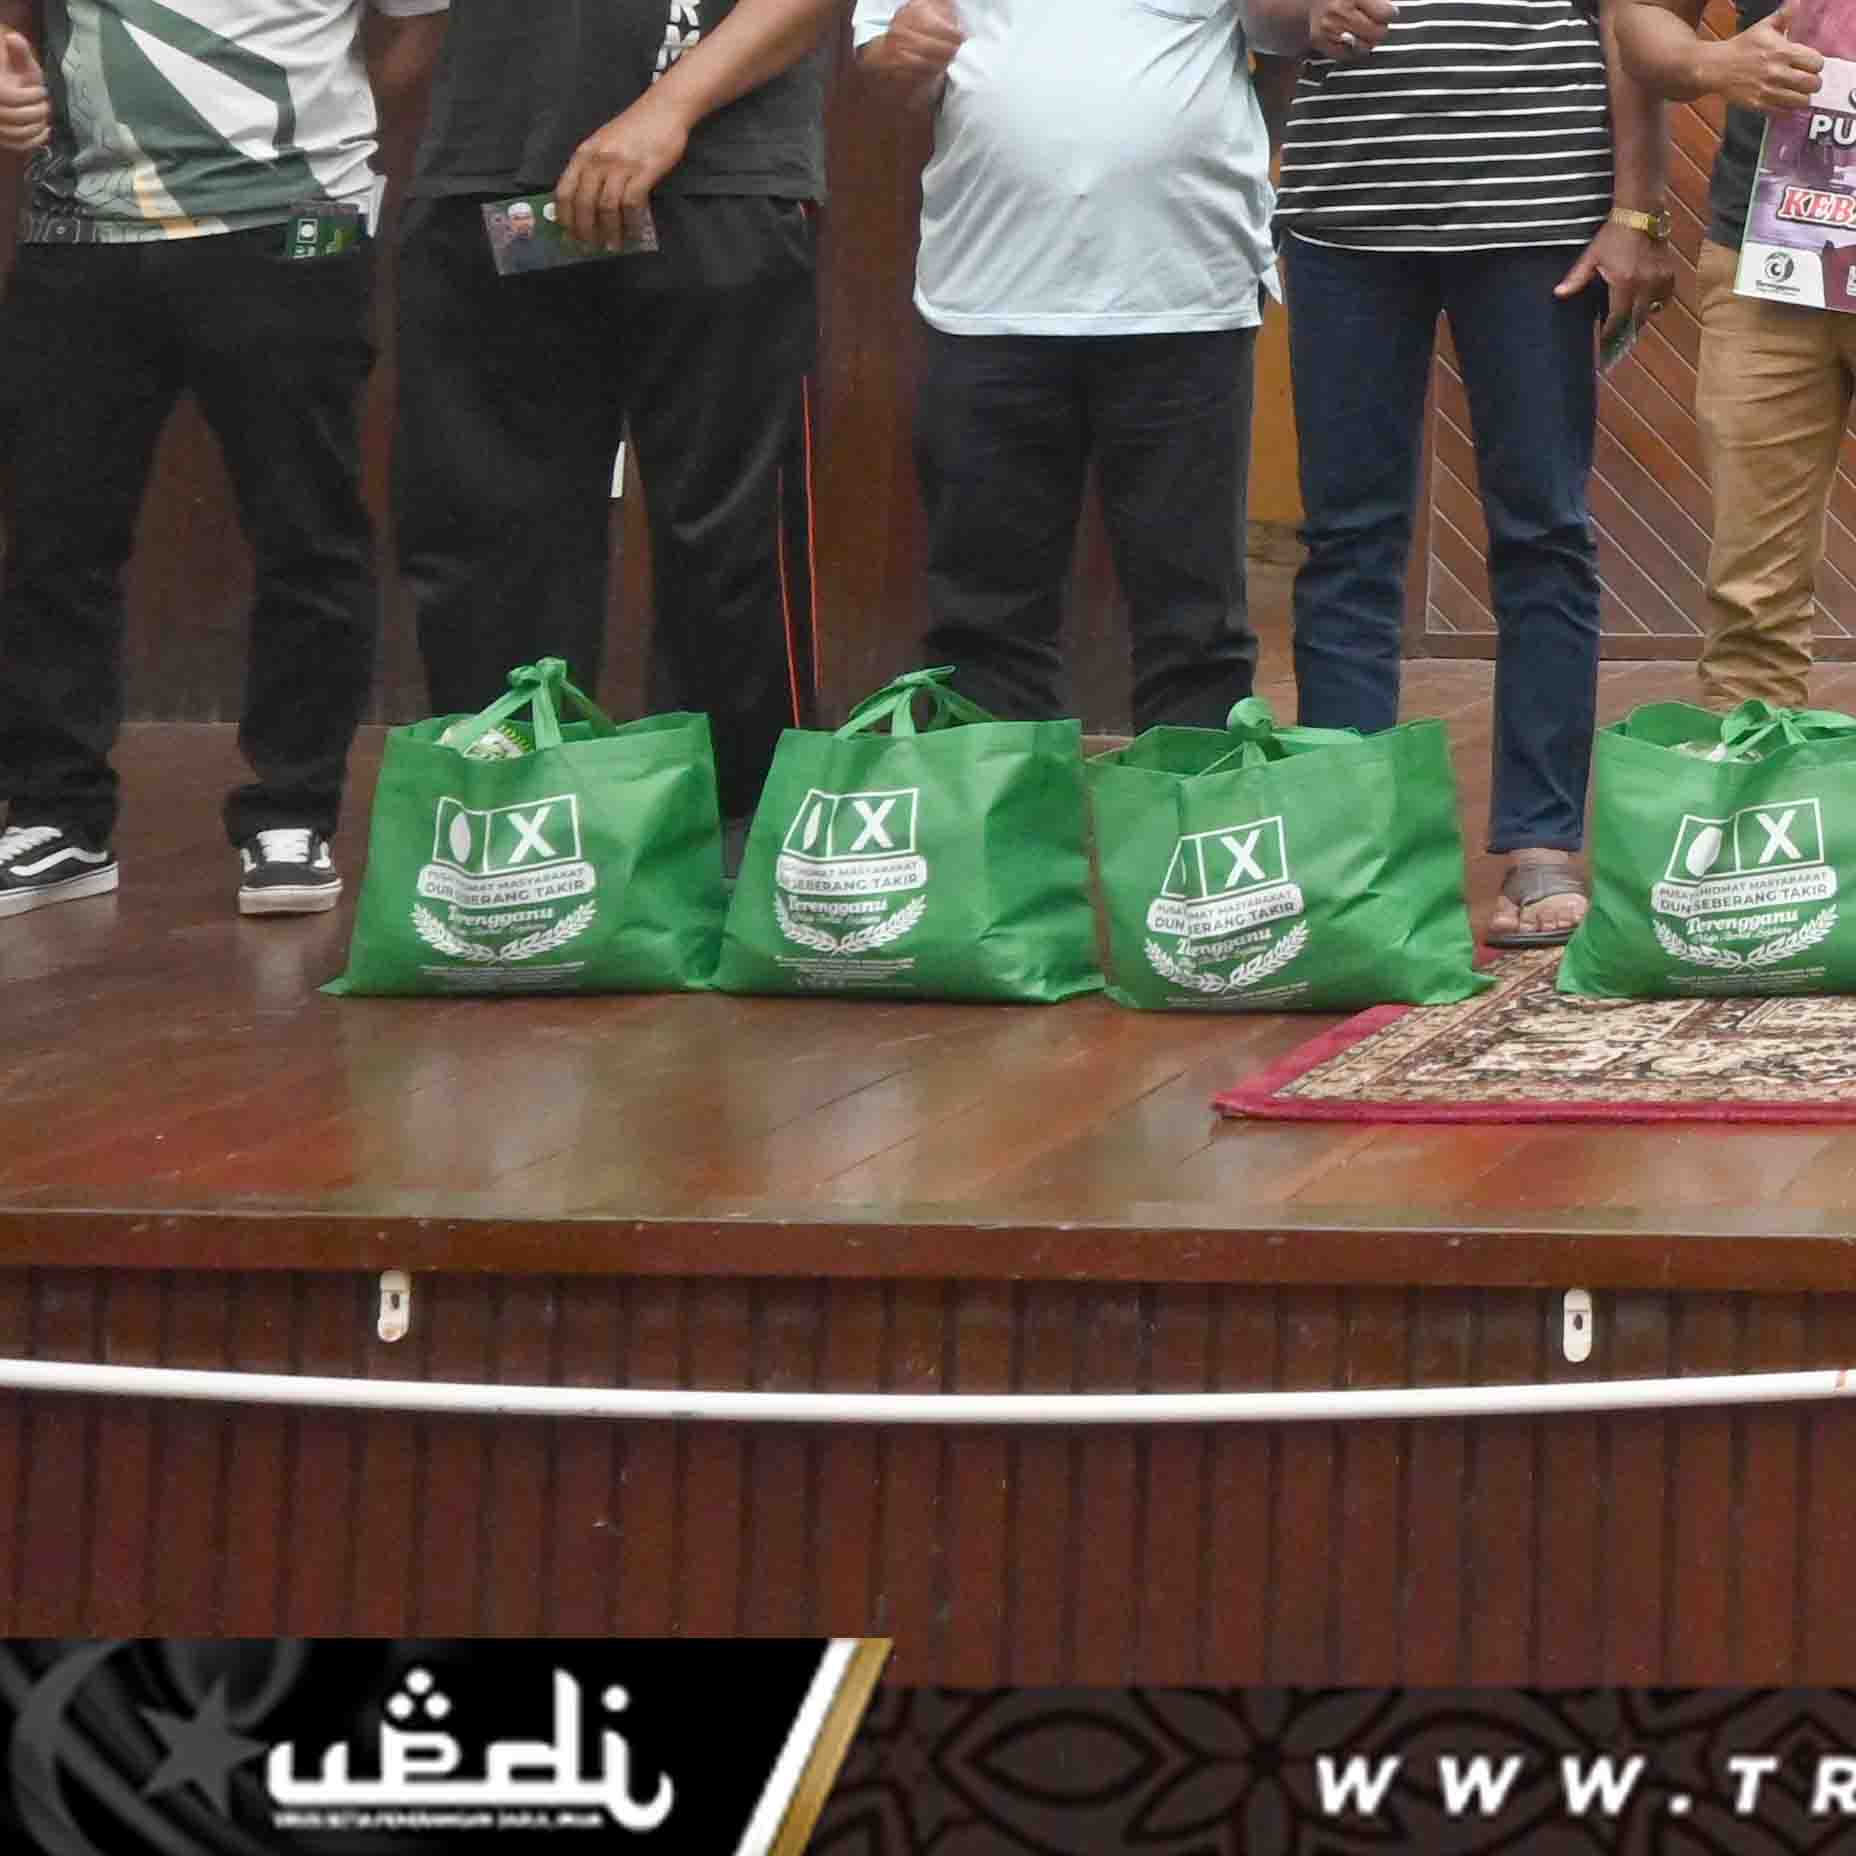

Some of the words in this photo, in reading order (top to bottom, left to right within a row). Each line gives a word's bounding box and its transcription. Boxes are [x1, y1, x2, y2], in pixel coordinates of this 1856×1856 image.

[1659, 899, 1692, 915] DUN
[1693, 894, 1777, 911] SEBERANG
[1782, 885, 1828, 900] TAKIR
[1154, 917, 1185, 931] DUN
[1250, 901, 1295, 921] TAKIR
